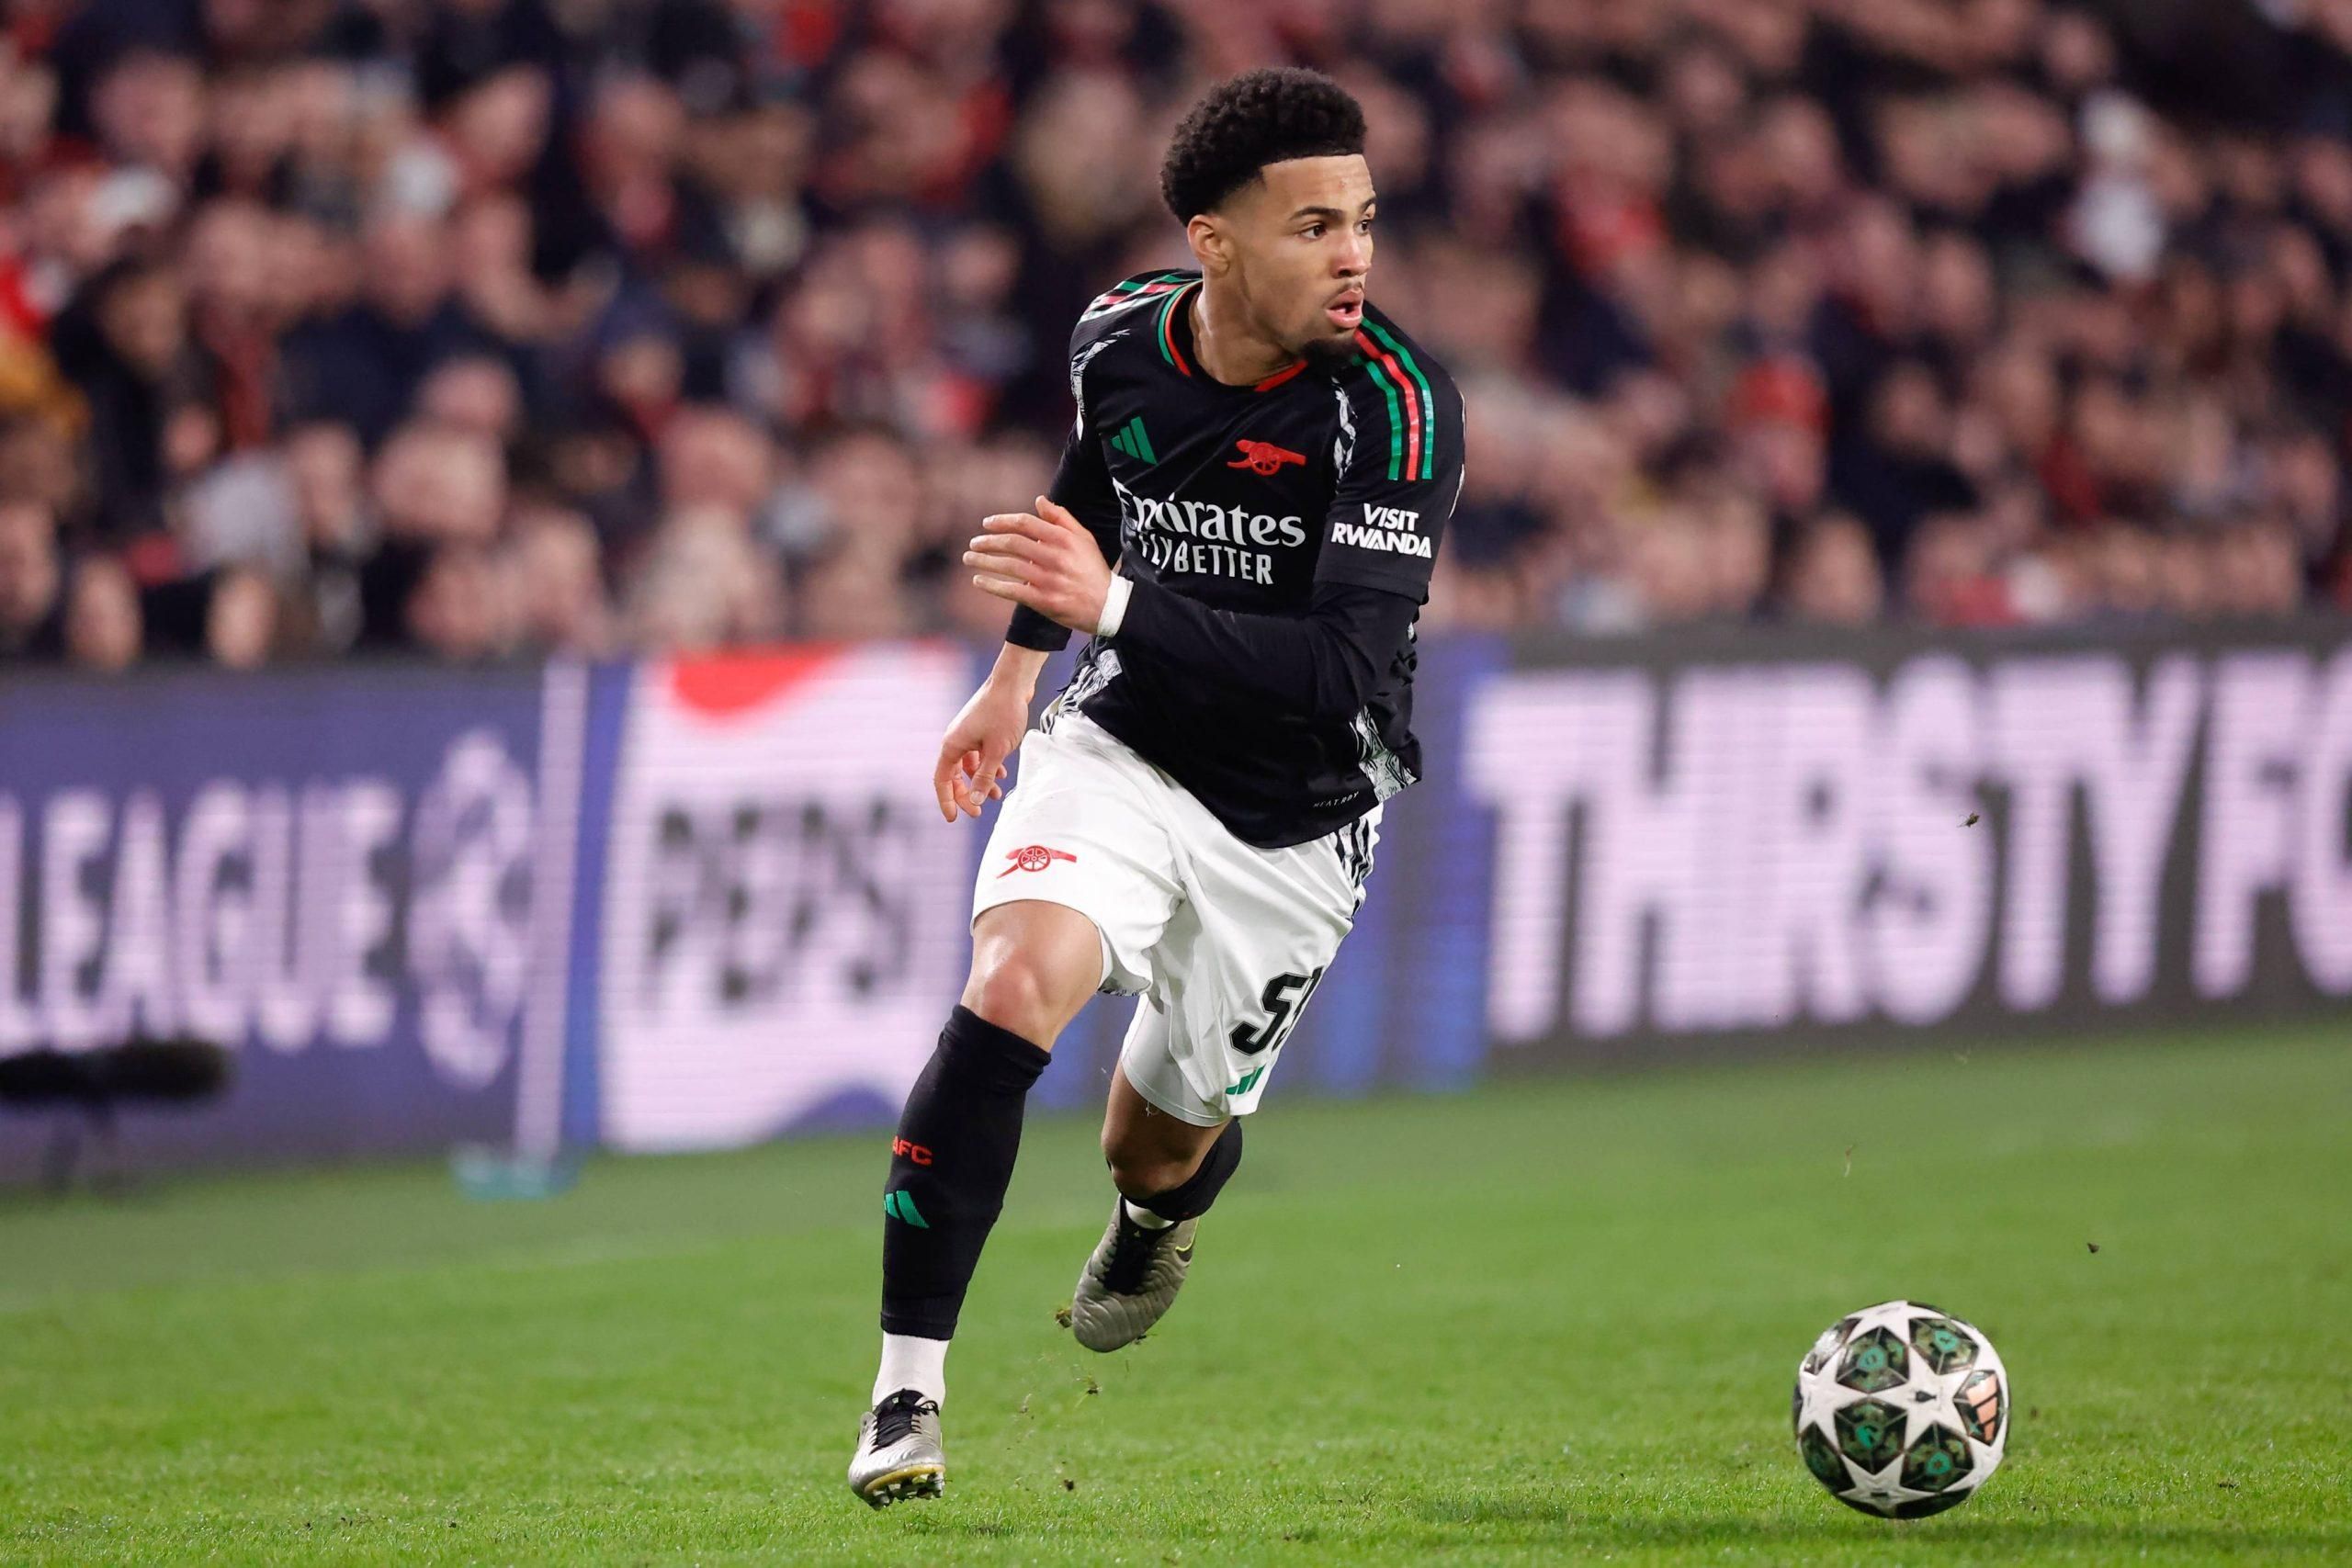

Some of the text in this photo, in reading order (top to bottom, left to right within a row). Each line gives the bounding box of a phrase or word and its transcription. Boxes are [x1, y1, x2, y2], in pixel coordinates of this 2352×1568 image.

[1113, 477, 1306, 547] Emirates
[1363, 502, 1419, 532] VISIT
[1330, 522, 1432, 558] RWANDA
[1472, 650, 2203, 1040] THIRSTY
[891, 1135, 933, 1166] AFC
